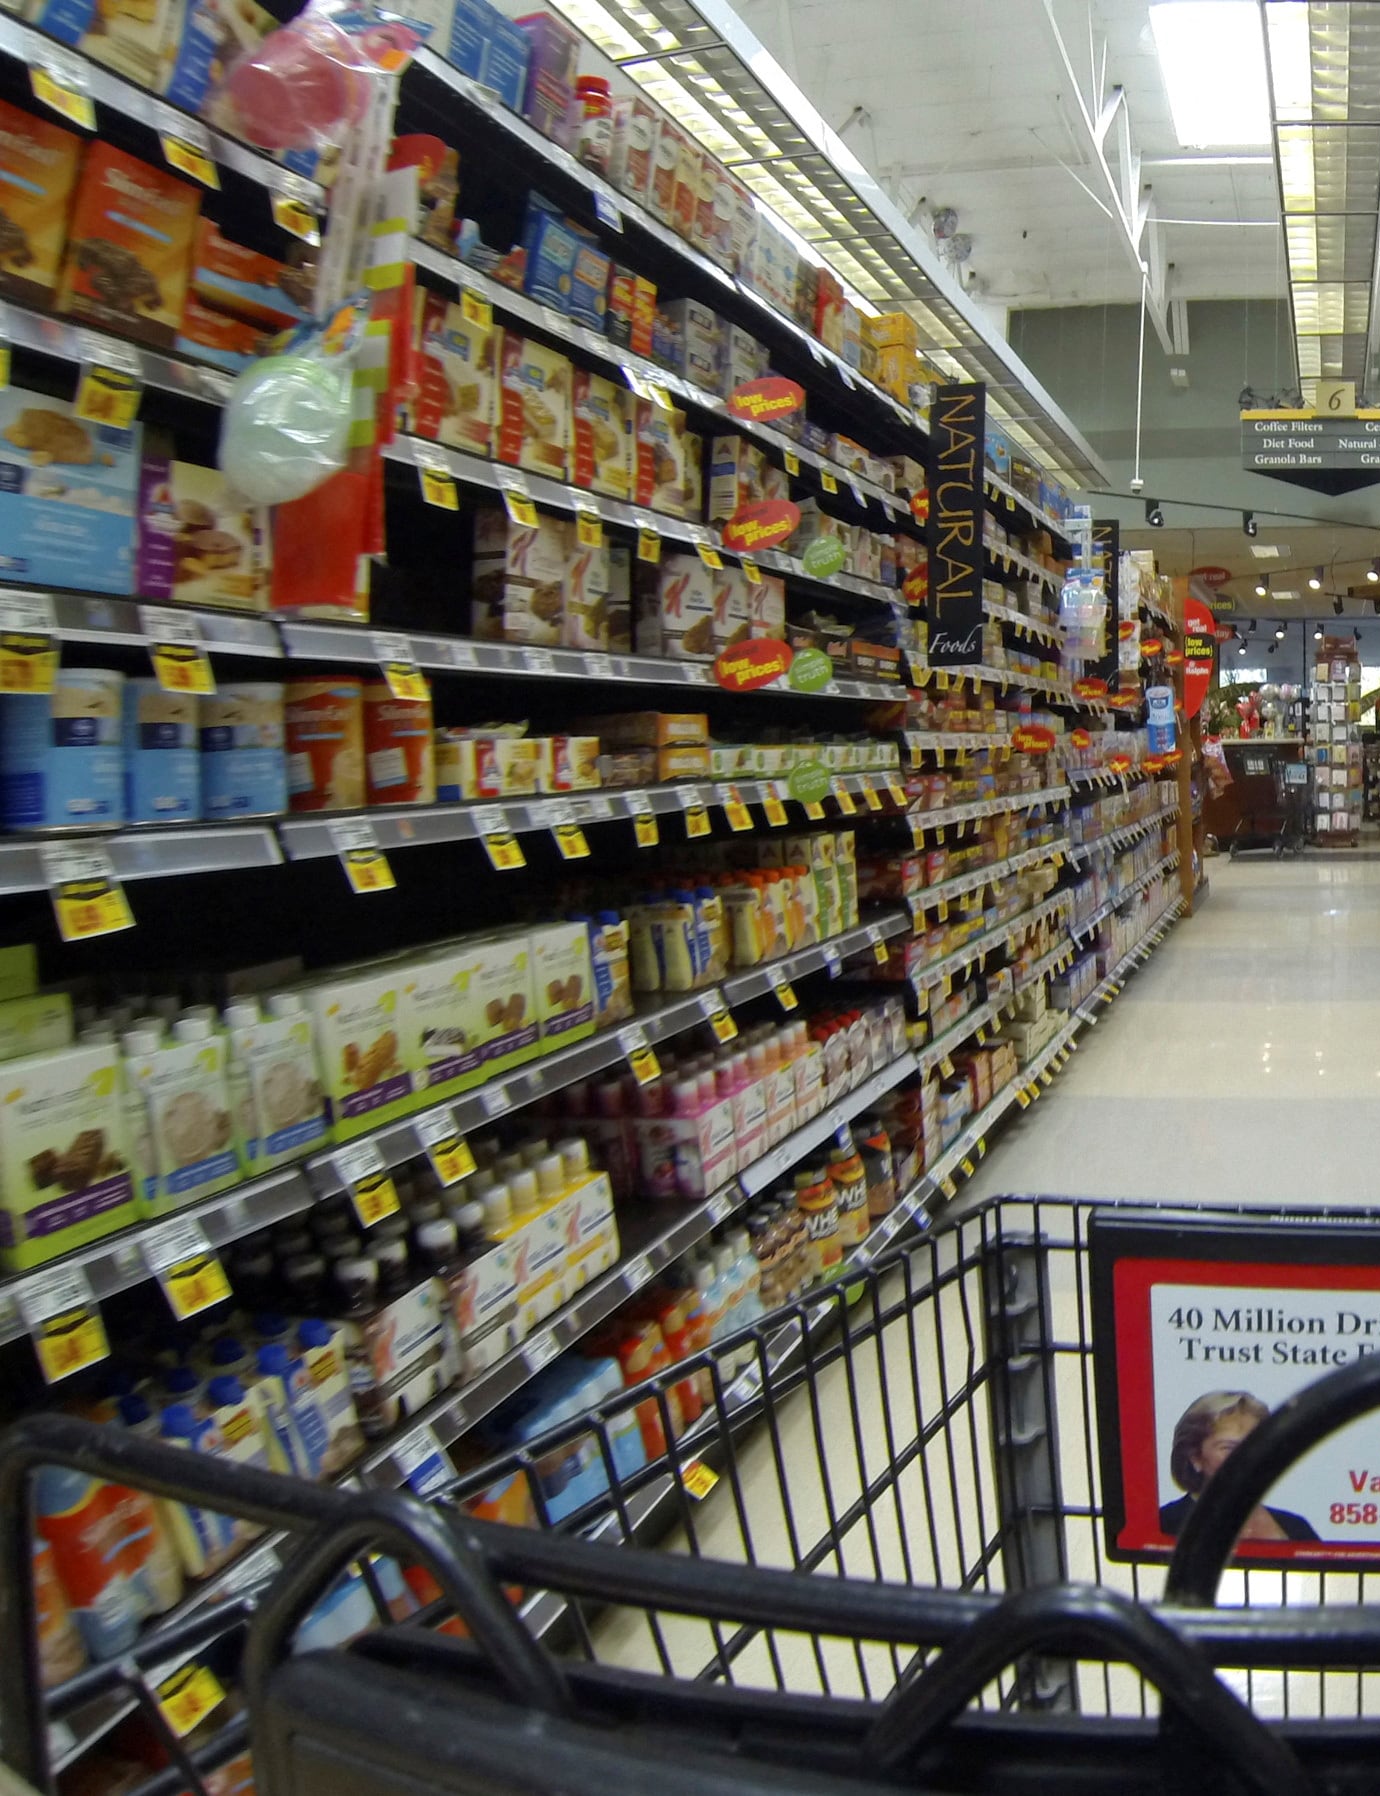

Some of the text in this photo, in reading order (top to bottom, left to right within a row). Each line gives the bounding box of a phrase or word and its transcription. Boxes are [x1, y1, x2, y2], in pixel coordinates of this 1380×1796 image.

[1328, 388, 1345, 411] 6
[1254, 421, 1323, 432] Coffee Filters
[1263, 438, 1314, 448] Diet Food
[1338, 438, 1377, 449] Natural
[1254, 454, 1322, 465] Granola Bars
[936, 393, 977, 619] NATURAL
[929, 623, 984, 655] Foods
[1168, 1307, 1203, 1331] 40
[1213, 1308, 1325, 1334] Million
[1179, 1336, 1264, 1364] Trust
[1272, 1341, 1348, 1366] State
